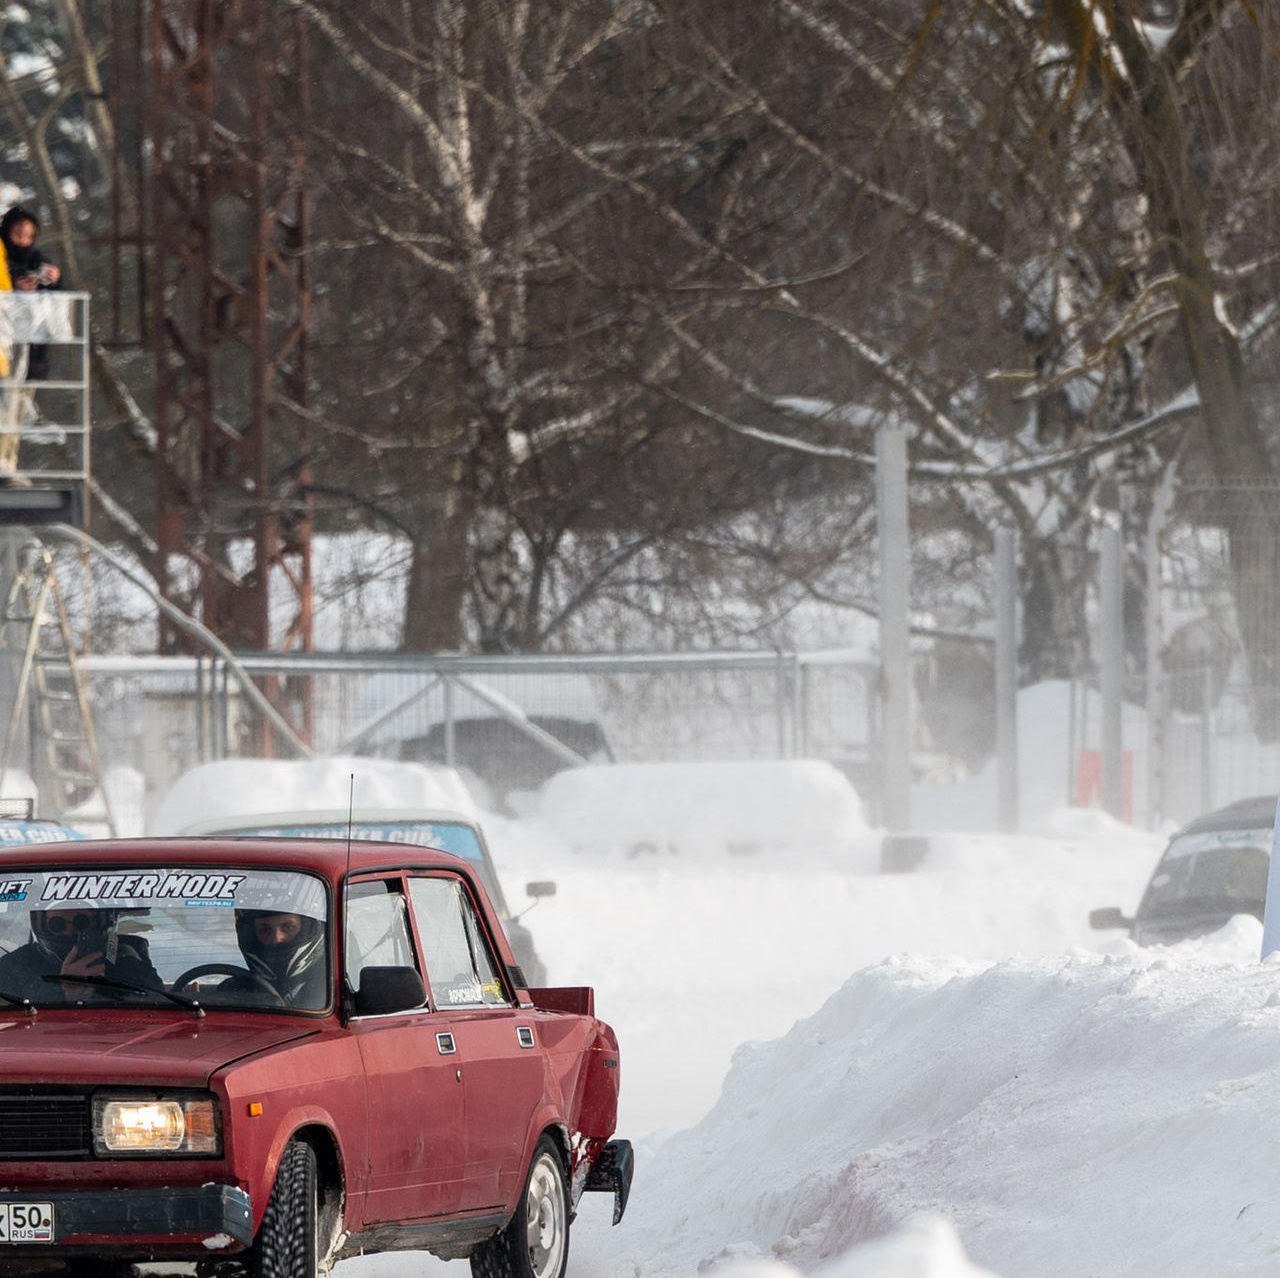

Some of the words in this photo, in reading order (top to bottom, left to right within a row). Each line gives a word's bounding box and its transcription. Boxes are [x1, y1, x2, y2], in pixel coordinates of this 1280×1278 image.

[26, 828, 68, 843] CUP
[41, 873, 160, 901] WINTER
[157, 873, 246, 900] MODE
[13, 1206, 42, 1229] 50
[12, 1229, 33, 1239] RUS
